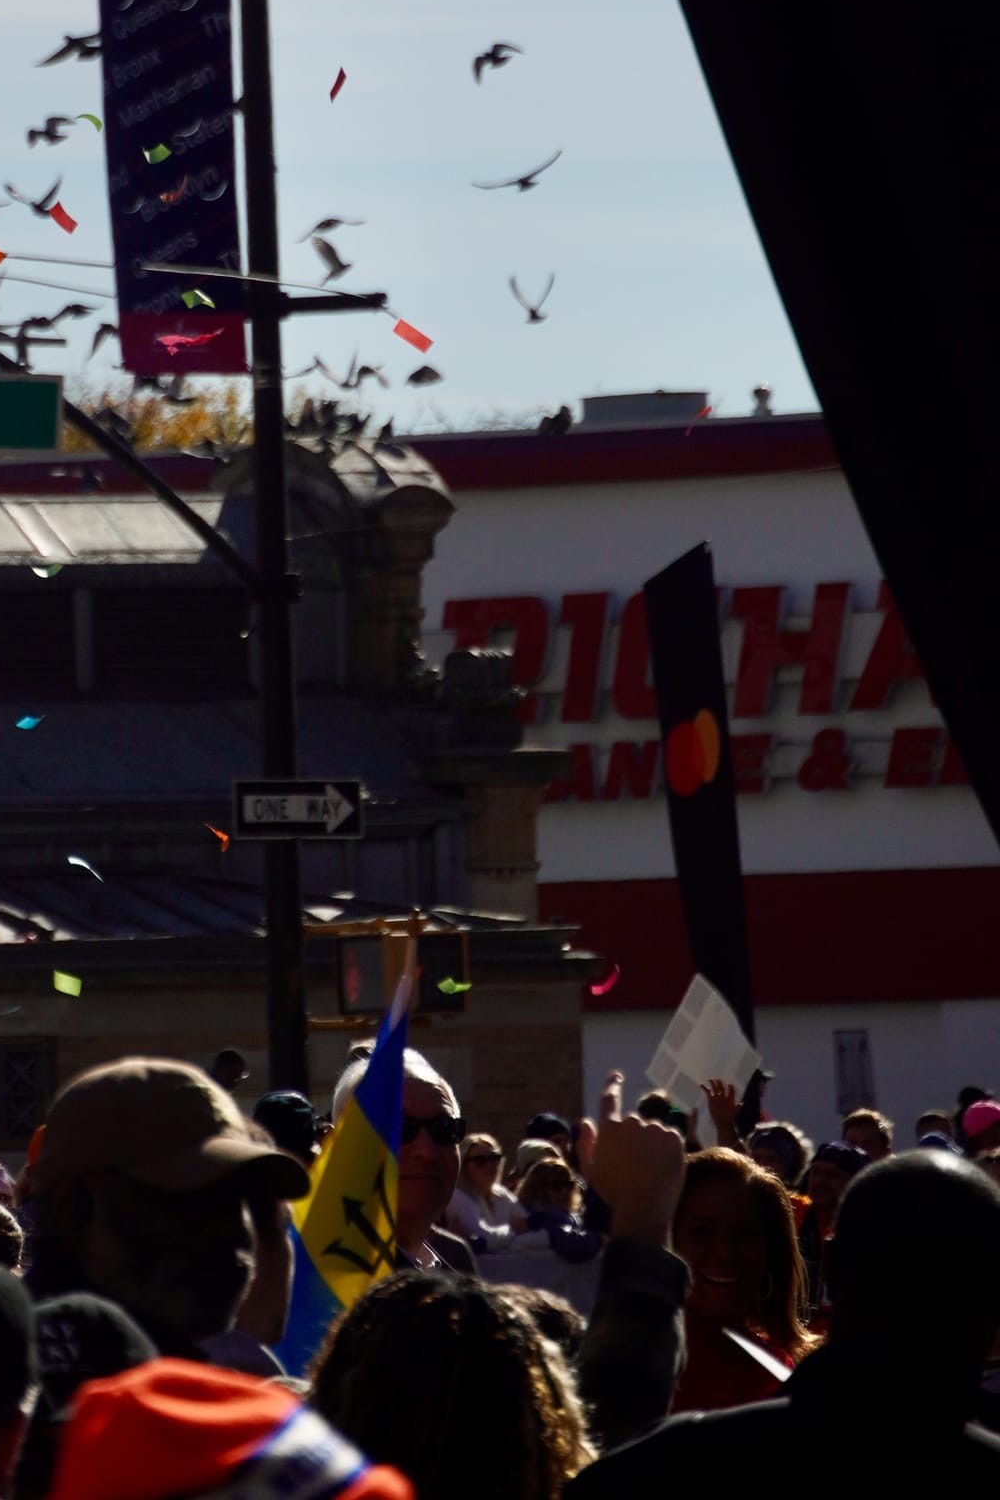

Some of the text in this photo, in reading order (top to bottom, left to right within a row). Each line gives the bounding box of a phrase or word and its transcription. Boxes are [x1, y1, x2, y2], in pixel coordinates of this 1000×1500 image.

[111, 48, 163, 88] Bronx
[118, 64, 216, 130] Manhattan
[132, 231, 199, 279] Qeens
[543, 733, 773, 804] ANE
[254, 799, 342, 821] ONE WAY
